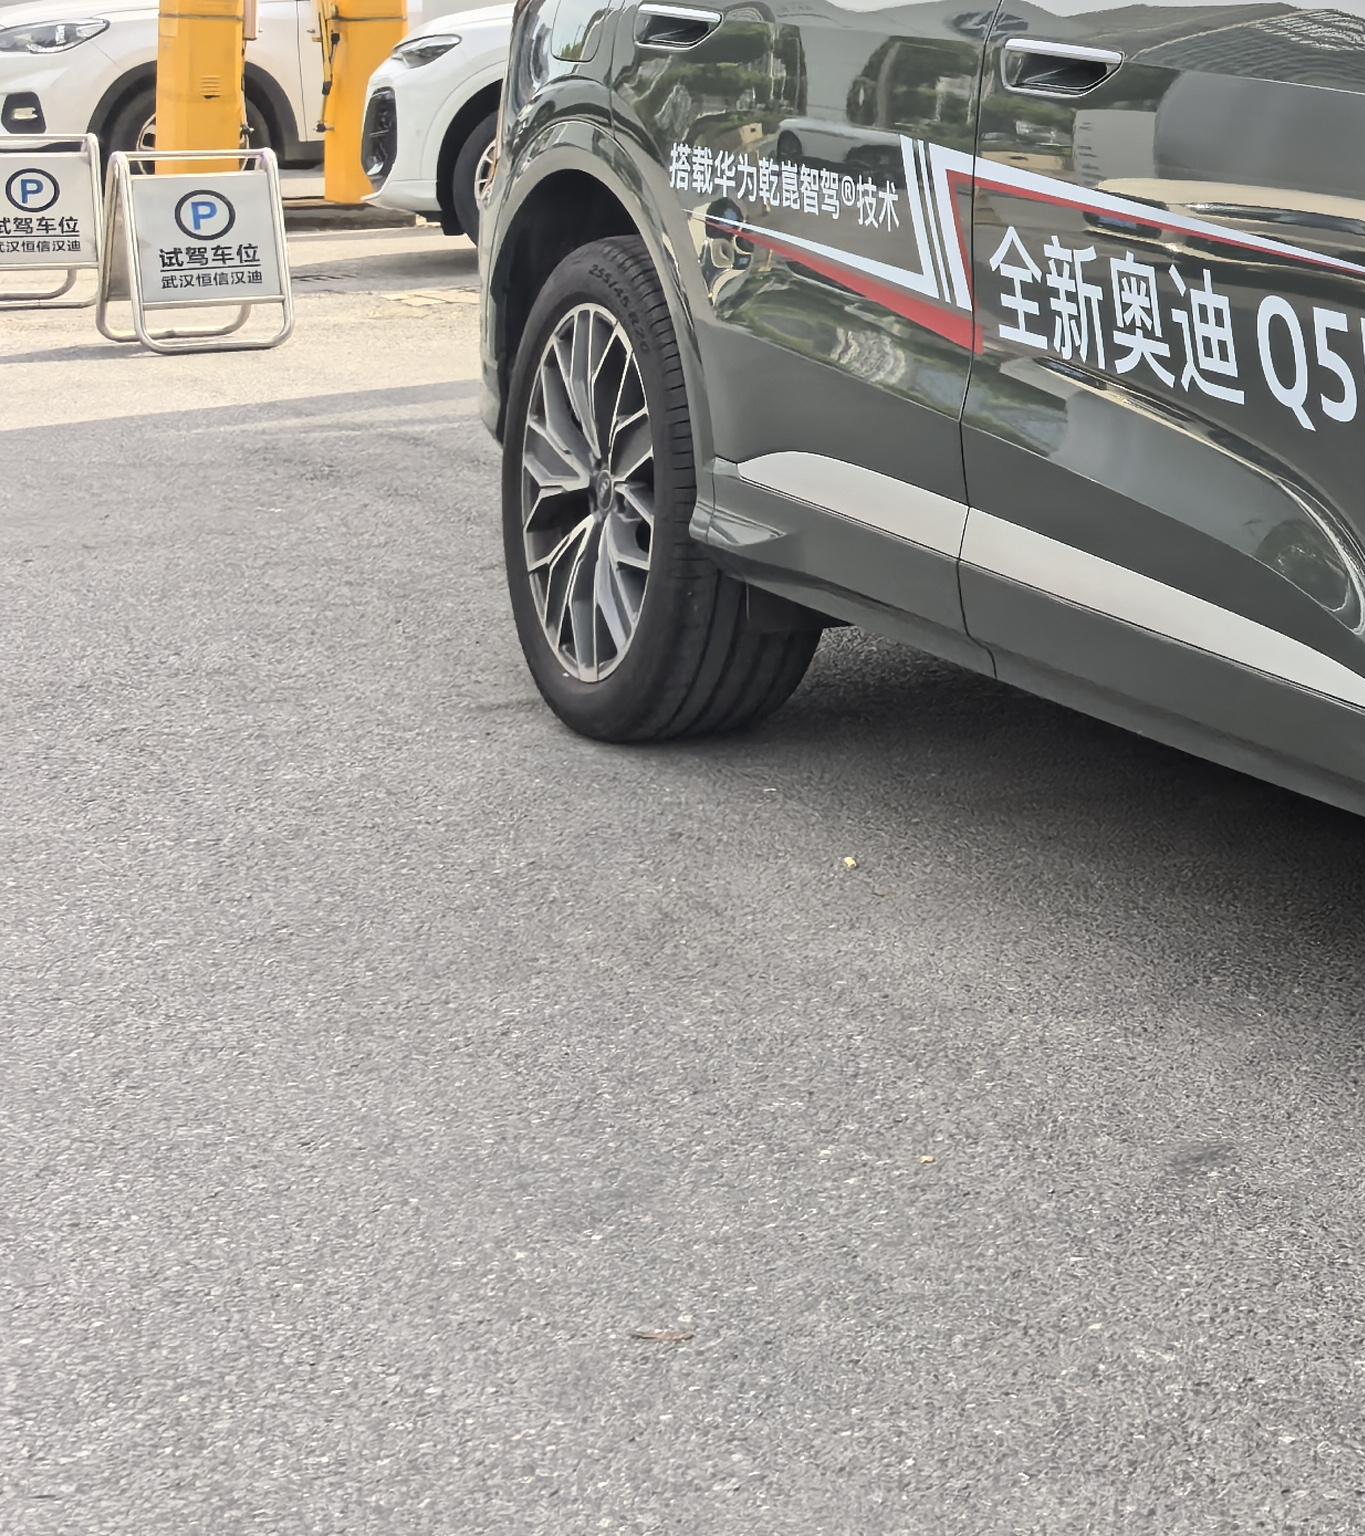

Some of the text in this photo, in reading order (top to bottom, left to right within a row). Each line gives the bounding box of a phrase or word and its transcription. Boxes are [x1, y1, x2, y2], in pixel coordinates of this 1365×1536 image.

[21, 178, 43, 204] P
[191, 201, 217, 230] P
[159, 243, 261, 268] 试驾车位
[161, 270, 263, 289] 武汉恒信汉迪
[989, 226, 1245, 406] 全新奥迪
